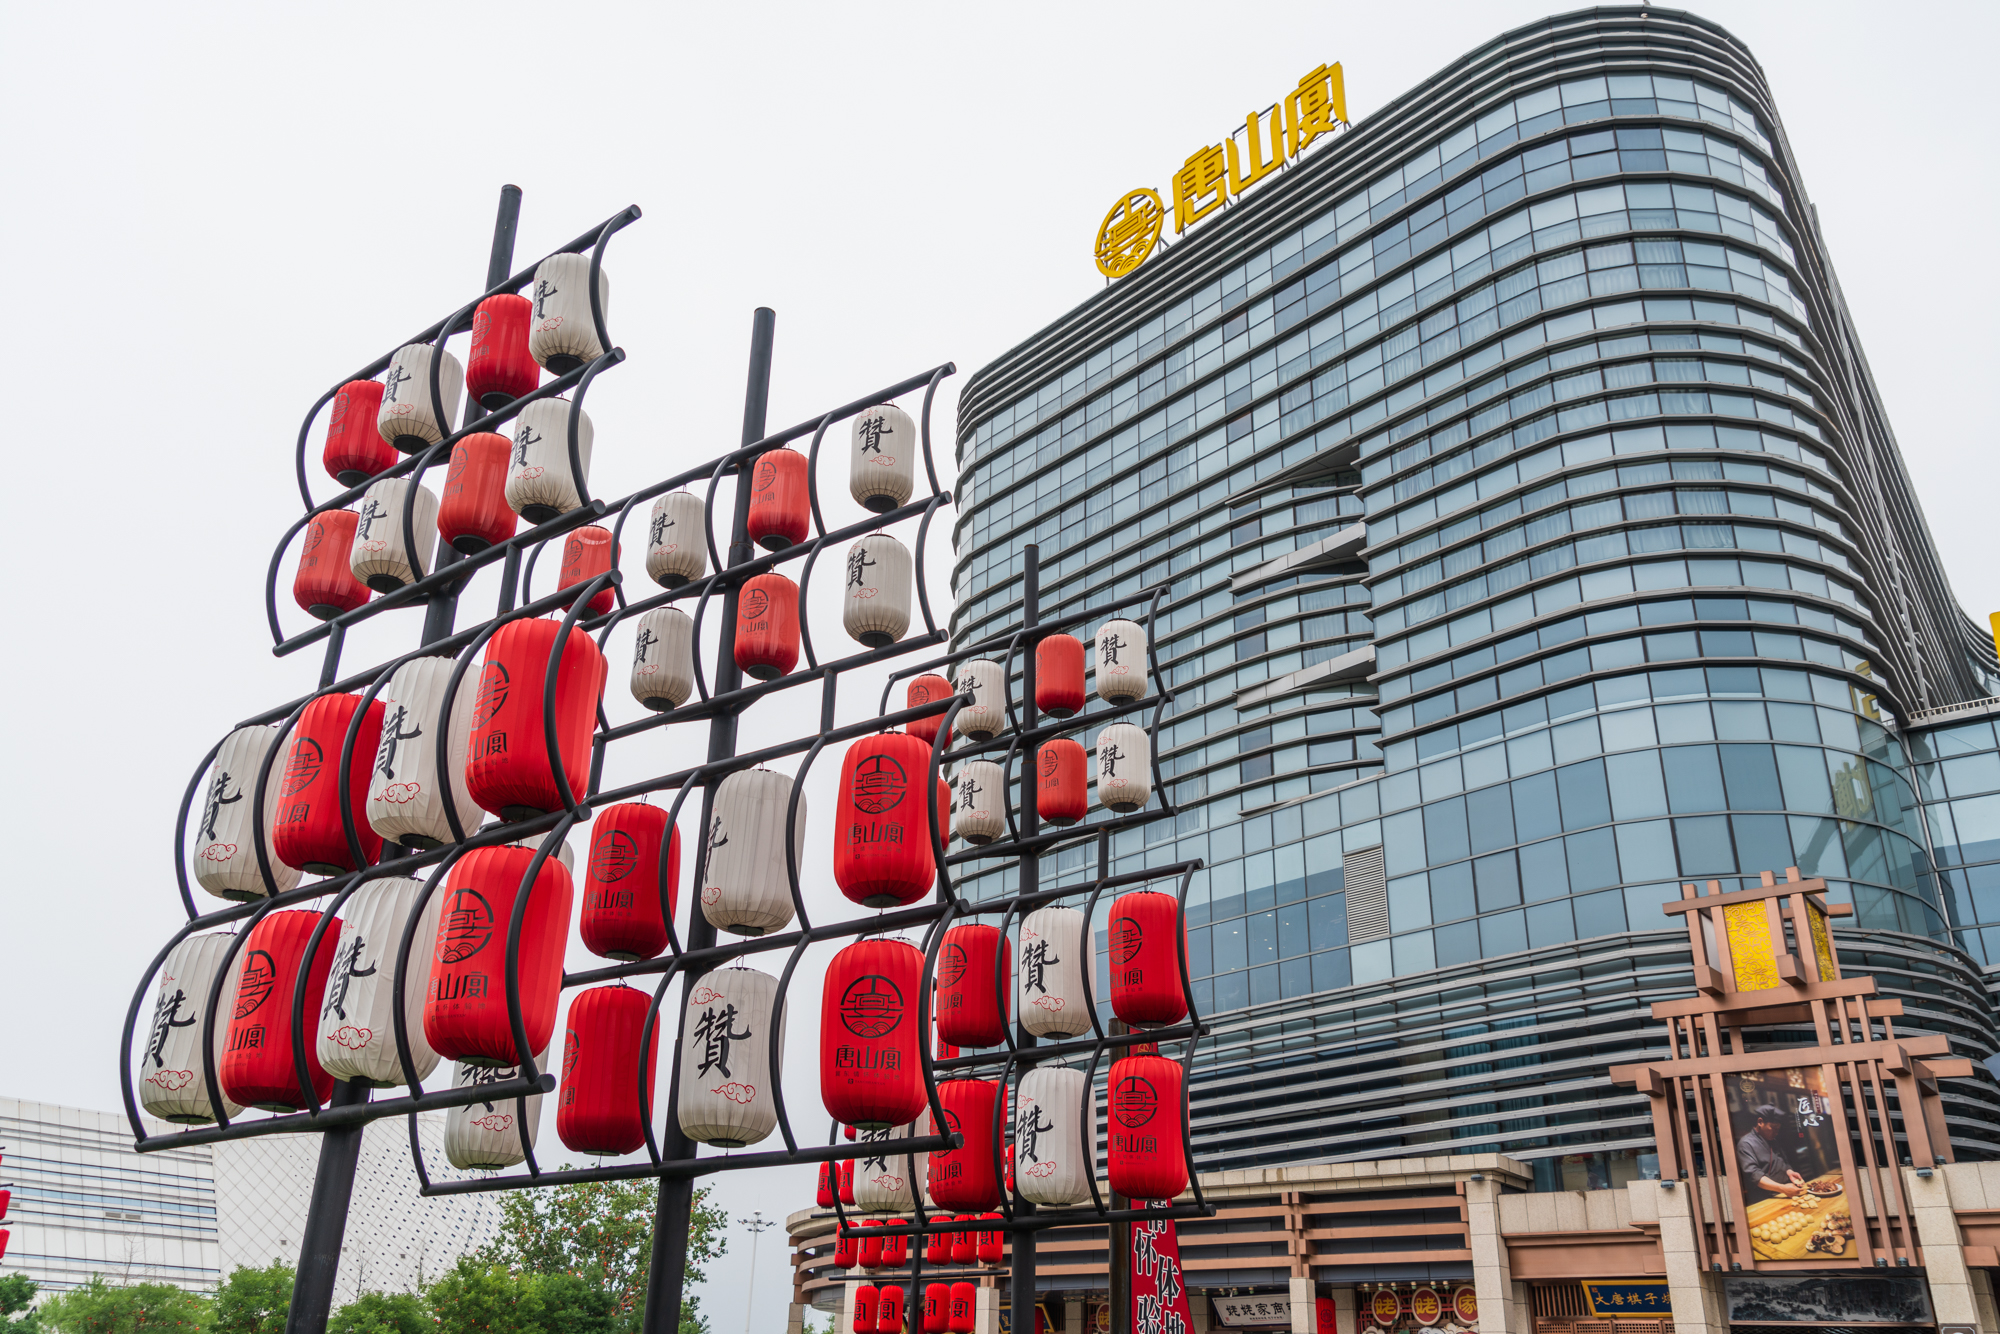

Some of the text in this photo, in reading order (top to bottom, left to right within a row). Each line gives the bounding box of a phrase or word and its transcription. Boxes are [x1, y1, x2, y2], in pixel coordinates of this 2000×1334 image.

[1172, 61, 1347, 234] 唐山宴
[466, 729, 507, 766] 山宴
[847, 821, 904, 846] 唐山宴
[835, 1044, 902, 1071] 唐山宴
[1112, 1133, 1157, 1154] 唐山宴
